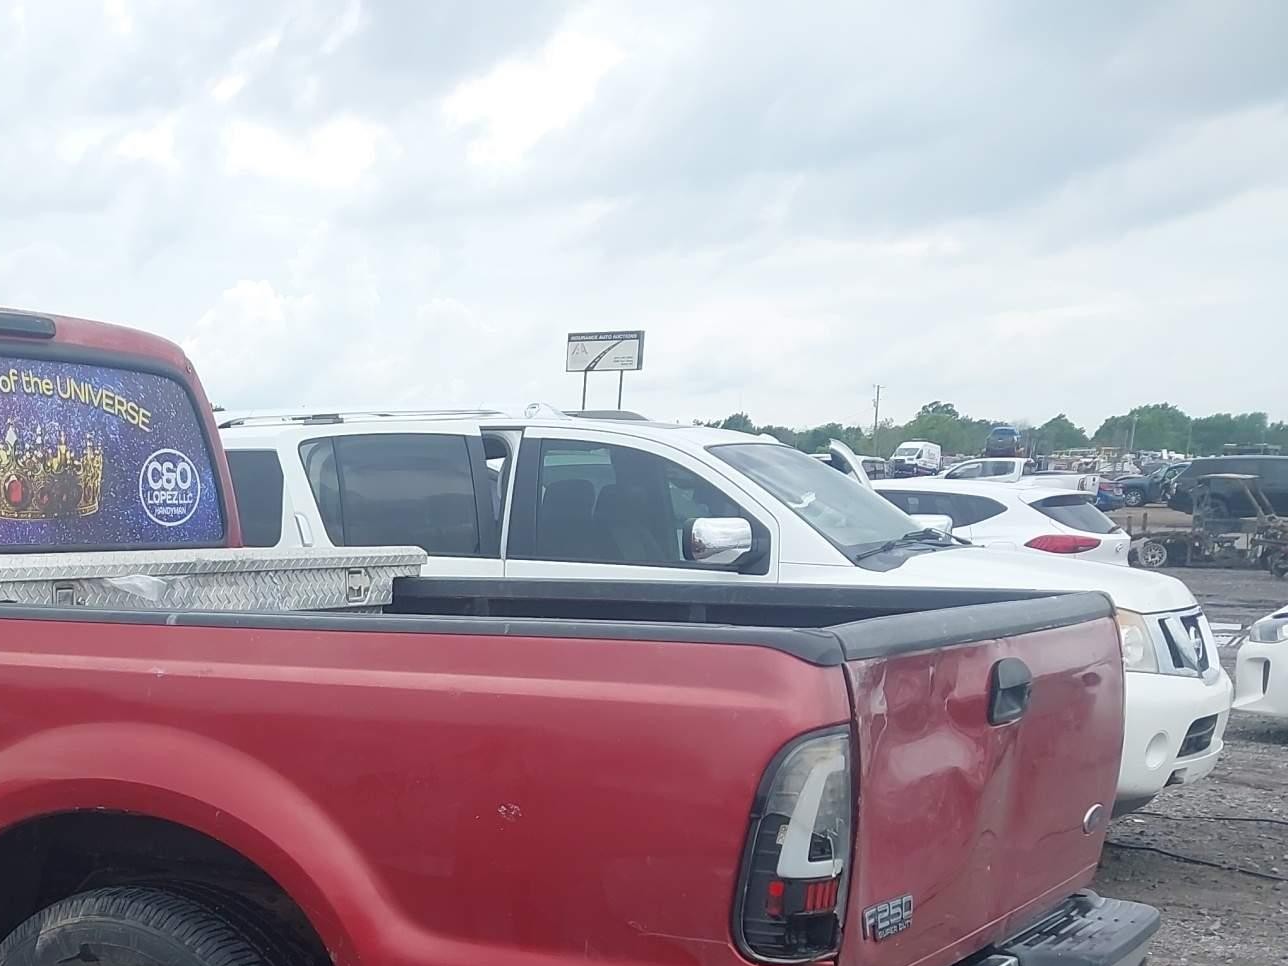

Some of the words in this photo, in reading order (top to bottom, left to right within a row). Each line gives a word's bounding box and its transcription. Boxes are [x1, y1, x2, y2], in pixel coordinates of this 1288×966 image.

[21, 369, 53, 396] the
[56, 376, 152, 432] UNIVERSE
[147, 491, 178, 503] LOPEZ
[178, 491, 193, 503] LLC
[878, 925, 898, 939] SUPER
